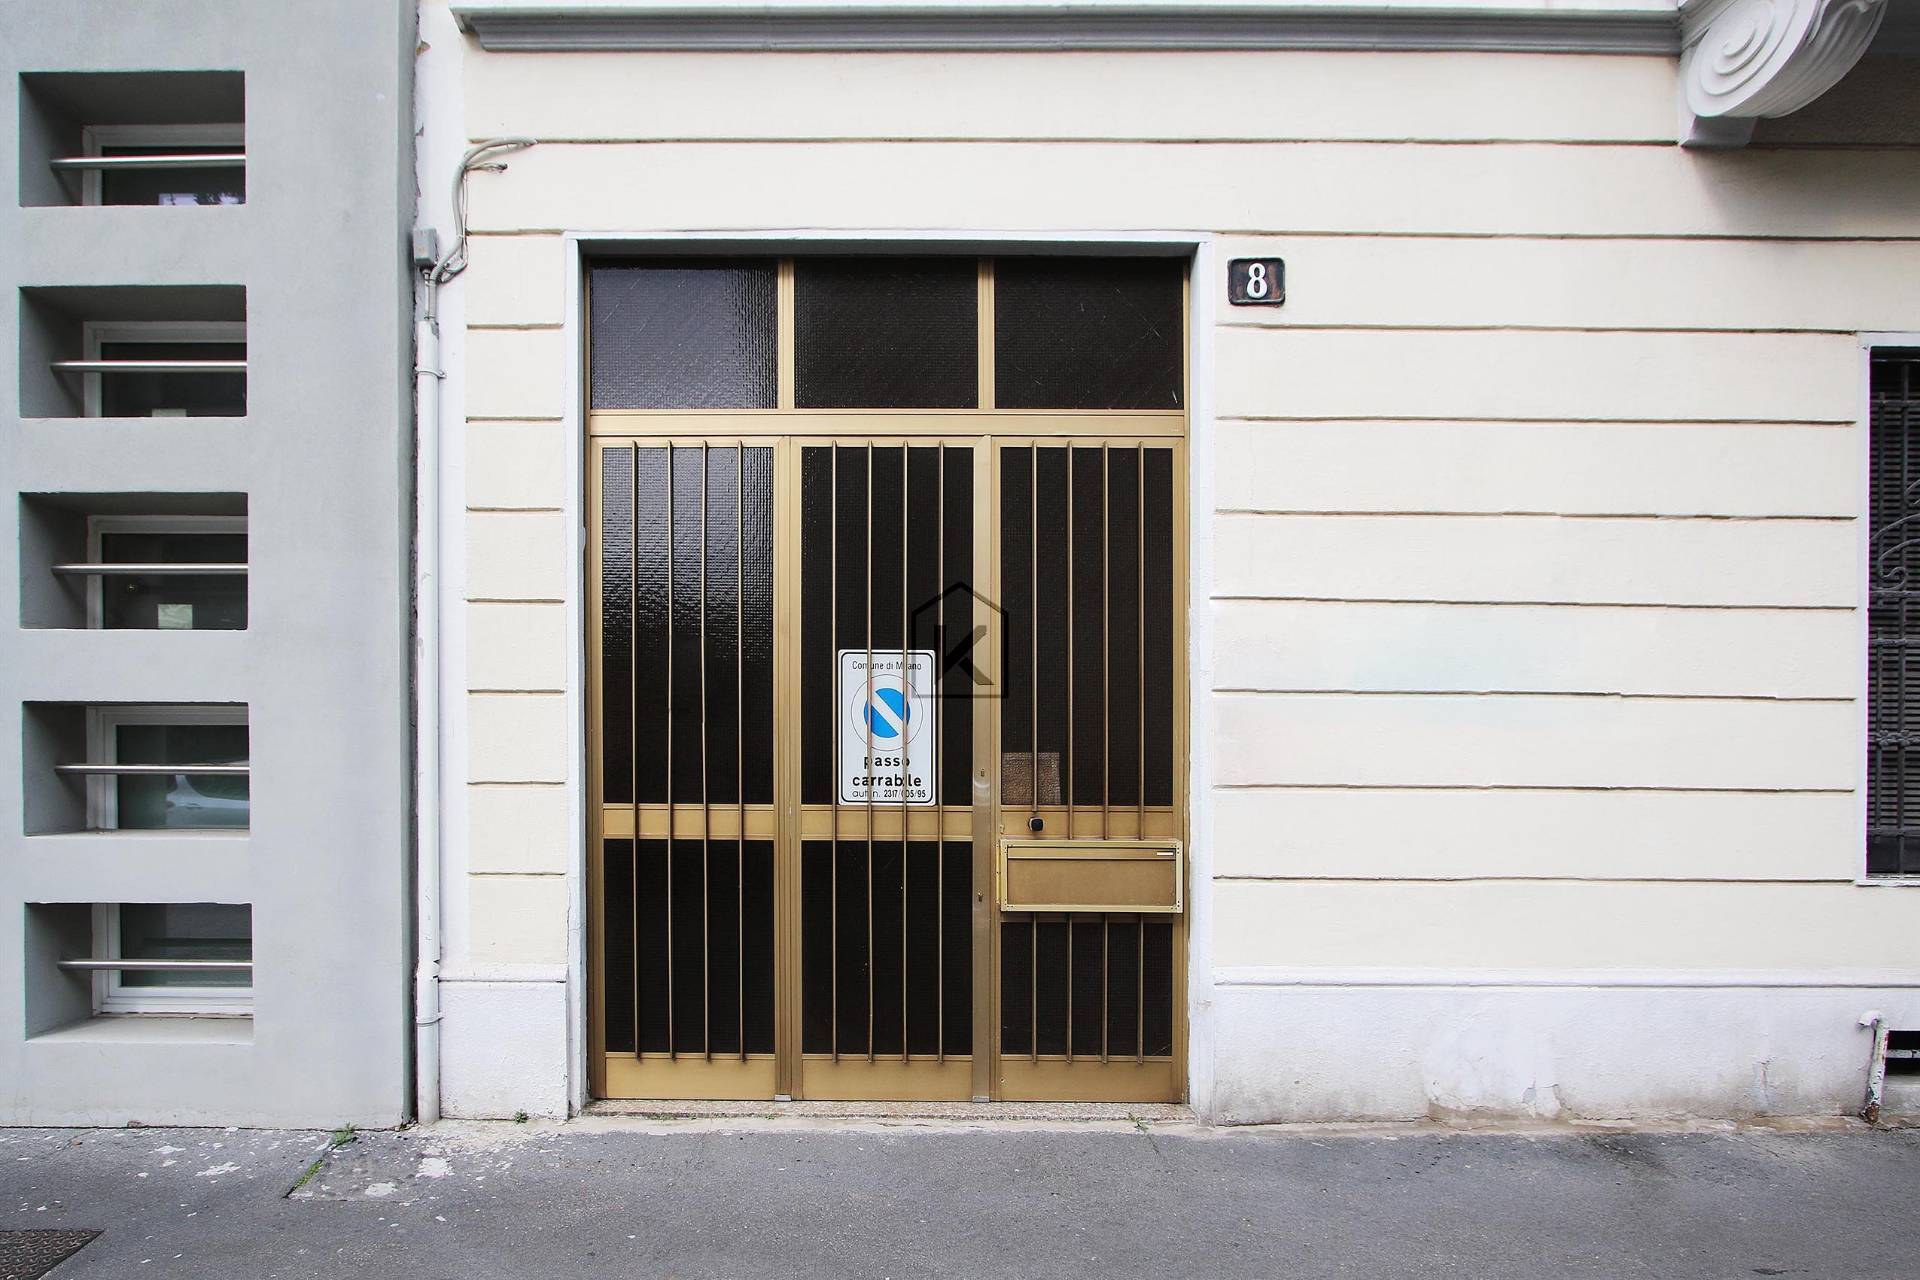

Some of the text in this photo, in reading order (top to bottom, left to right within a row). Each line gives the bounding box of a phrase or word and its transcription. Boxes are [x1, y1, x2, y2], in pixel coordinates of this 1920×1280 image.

[1246, 262, 1268, 299] 8
[886, 661, 894, 670] di
[895, 661, 922, 671] Mano
[863, 756, 911, 770] passo
